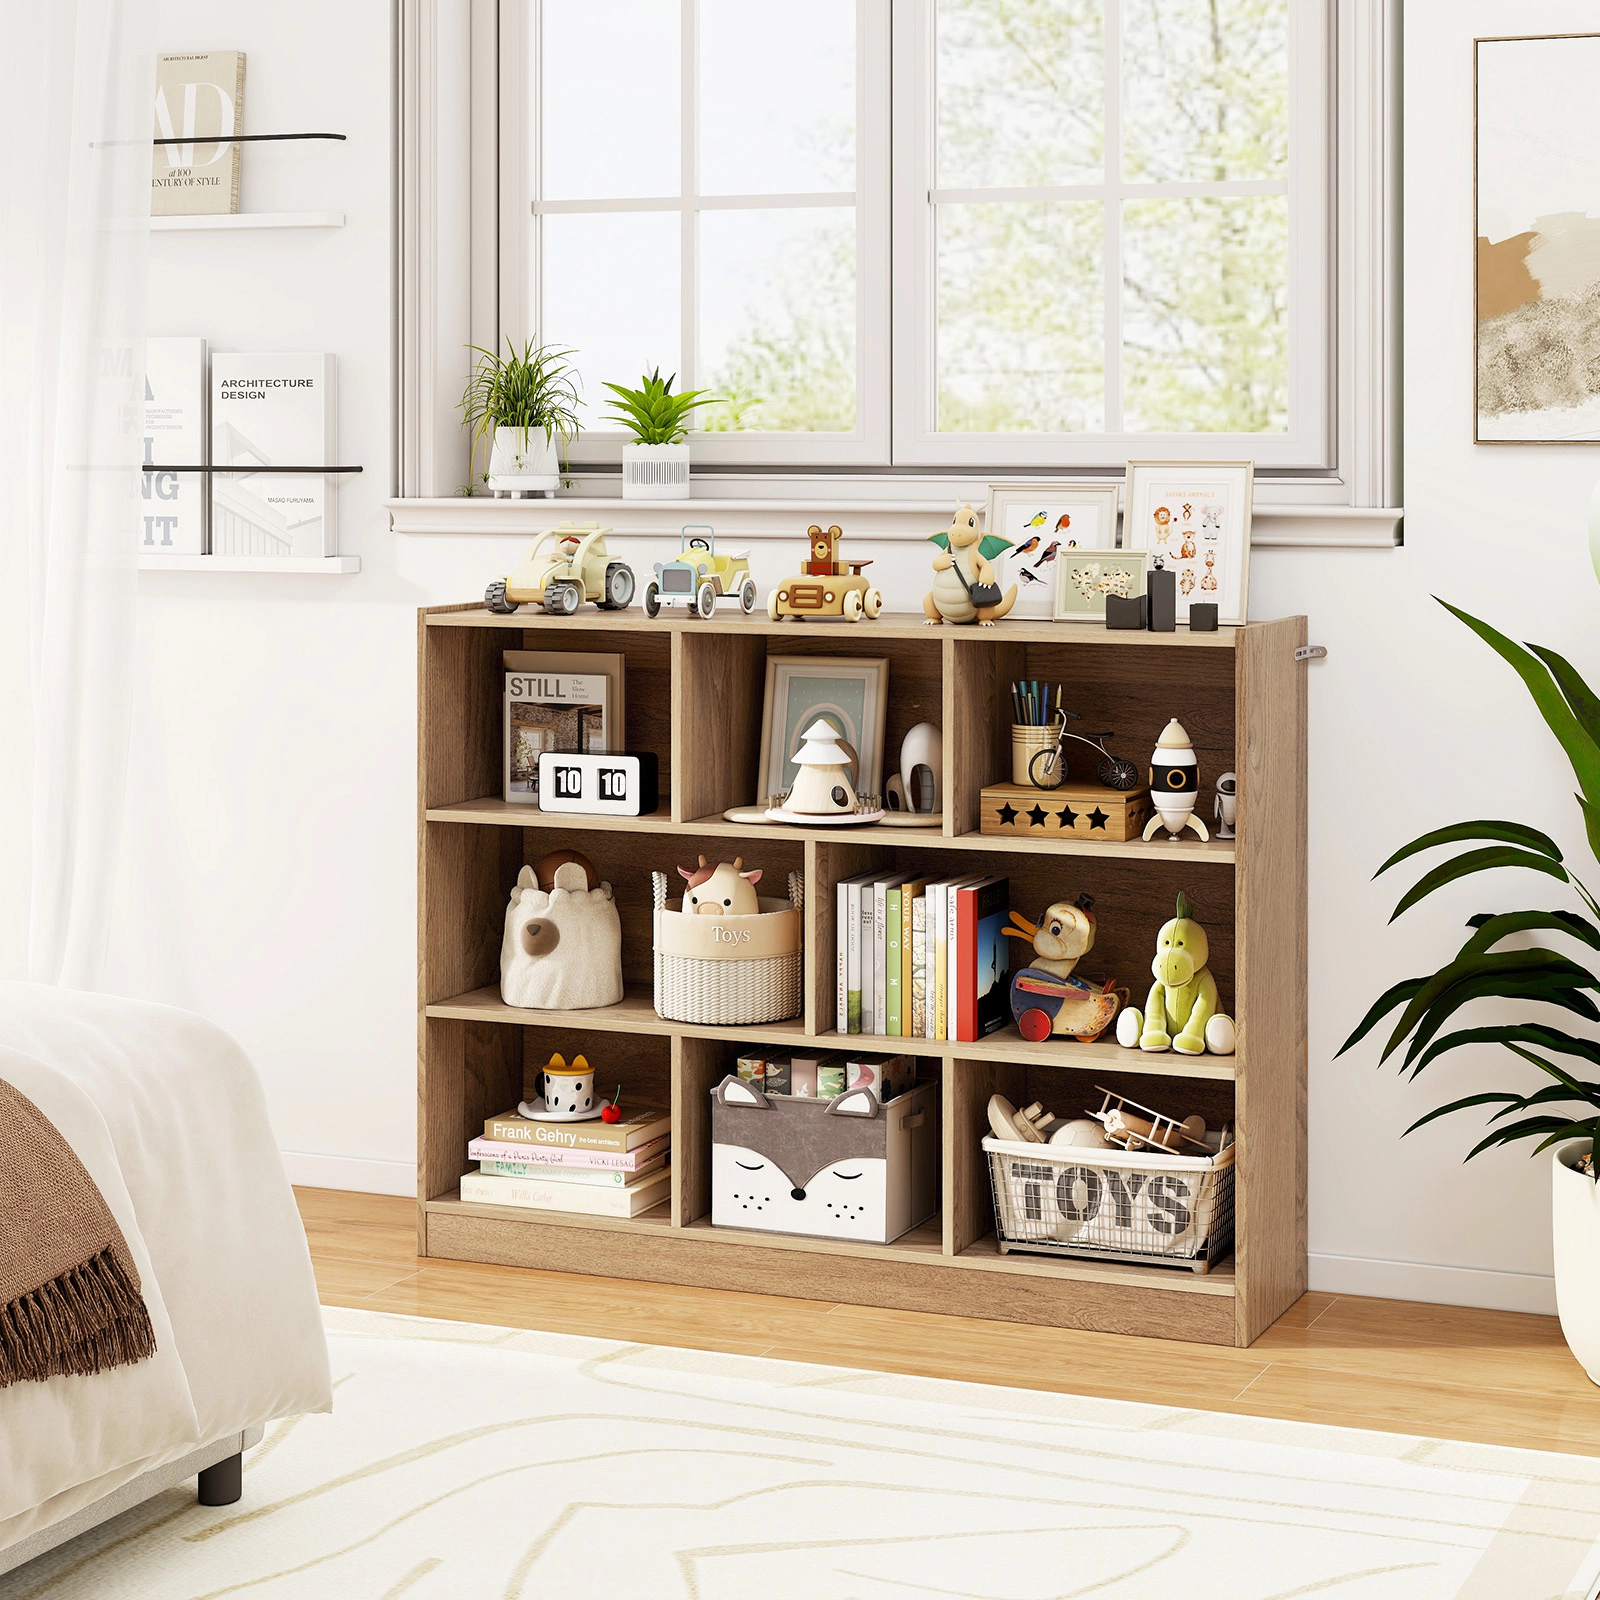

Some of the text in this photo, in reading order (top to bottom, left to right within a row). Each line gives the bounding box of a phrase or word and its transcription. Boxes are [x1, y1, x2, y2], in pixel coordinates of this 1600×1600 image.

[154, 82, 235, 168] AD
[152, 177, 220, 187] ENTURY OF STYLE
[177, 169, 191, 177] 100
[221, 379, 313, 388] ARCHITECTURE
[221, 391, 266, 400] DESIGN
[510, 677, 566, 698] STILL
[557, 770, 626, 796] 10 10
[875, 897, 884, 907] life
[949, 895, 957, 914] safe
[711, 926, 751, 947] Toys
[889, 903, 899, 1022] HOME
[493, 1123, 532, 1140] Frank
[535, 1127, 577, 1147] Gehry
[598, 1138, 620, 1146] architects
[470, 1148, 499, 1158] onfessions
[501, 1150, 508, 1160] of
[589, 1158, 609, 1166] VICKI
[495, 1162, 527, 1175] FAMILY
[1012, 1163, 1191, 1235] TOYS
